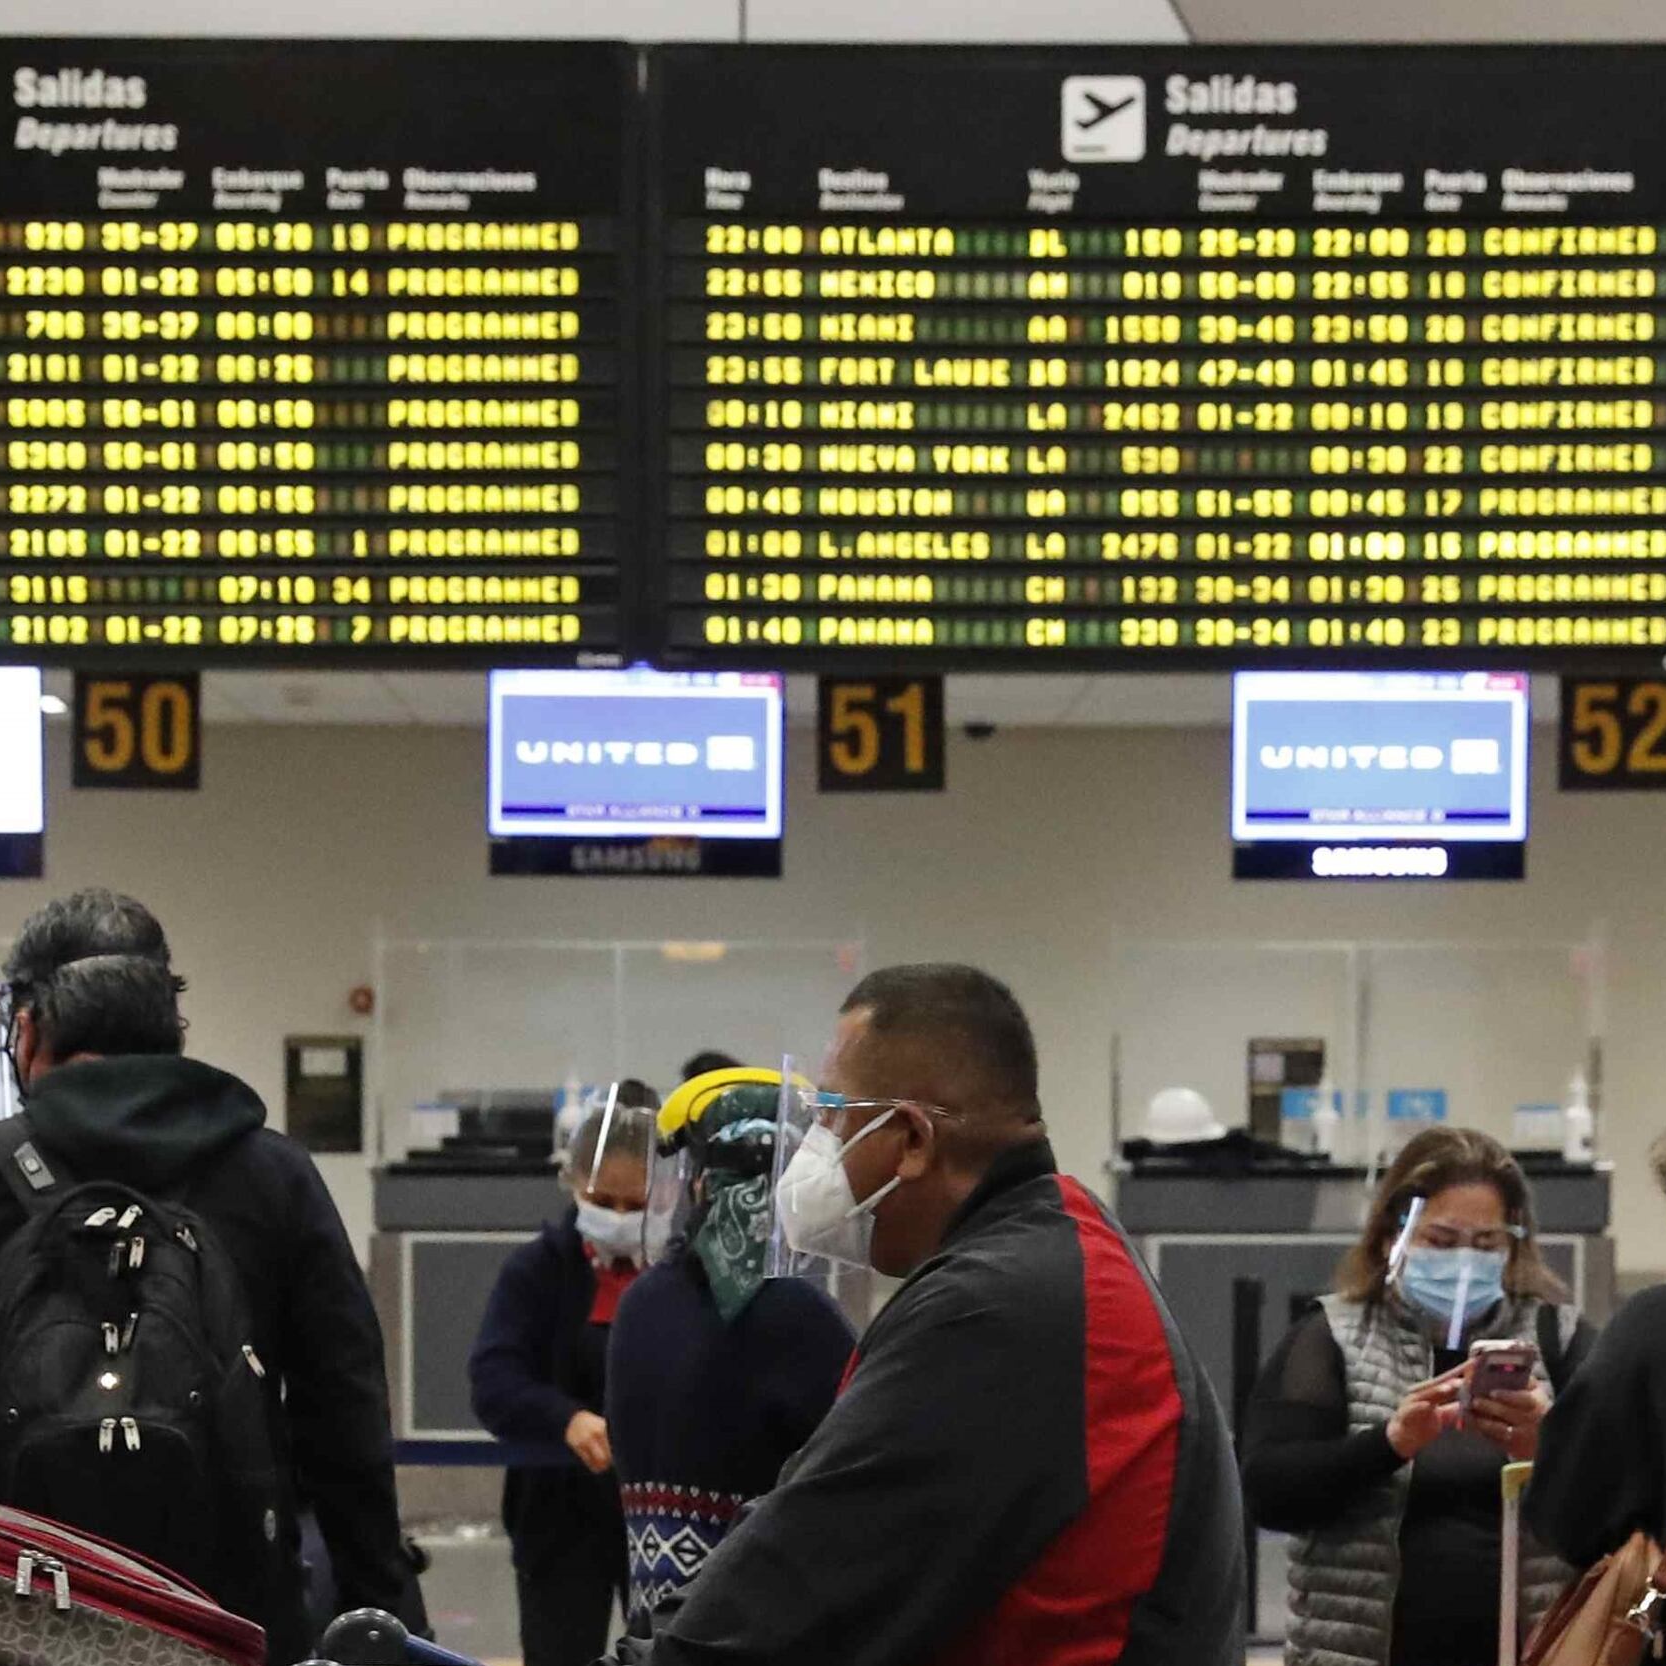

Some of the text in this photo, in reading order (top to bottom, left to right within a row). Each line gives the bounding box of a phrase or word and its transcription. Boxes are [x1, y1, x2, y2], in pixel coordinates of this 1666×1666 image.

[14, 66, 147, 109] Salidas
[1164, 73, 1297, 115] Salidas
[14, 116, 178, 157] Departures
[1165, 122, 1329, 162] Departures
[215, 222, 313, 251] 05:20
[387, 222, 579, 251] PROGRAMMED
[706, 225, 803, 255] 22:00
[819, 226, 954, 256] ATLANTA
[1313, 228, 1409, 257] 22:00
[1483, 226, 1656, 256] CONFIRMED
[101, 267, 199, 296] 01-22
[216, 267, 313, 297] 05:50
[333, 269, 369, 297] 14
[387, 267, 579, 296] PROGRAMMED
[706, 268, 803, 297] 22:55
[819, 269, 936, 299] MEXICO
[1312, 271, 1409, 300] 22:55
[1482, 270, 1655, 299] CONFIRMED
[216, 311, 313, 340] 06:00
[387, 311, 579, 340] PROGRAMMED
[706, 312, 1654, 343] 23:50 MIAMI AA 23:50 CONFIRMED
[102, 354, 200, 383] 01-22
[216, 354, 314, 383] 06:25
[388, 354, 578, 383] PROGRAMMED
[706, 356, 802, 385] 23:55
[1311, 358, 1408, 387] 01:45
[1481, 356, 1654, 386] CONFIRMED
[217, 399, 314, 428] 06:50
[388, 399, 579, 428] PROGRAMMED
[707, 399, 1653, 431] 00:10 MIAMI LA 01-22 00:10 CONFIRMED
[217, 441, 315, 470] 06:50
[388, 441, 579, 470] PROGRAMMED
[706, 442, 802, 472] 00:30
[819, 444, 916, 473] NUEVA
[932, 445, 1009, 474] YORK
[1027, 446, 1066, 474] LA
[1310, 445, 1407, 474] 00:30
[1480, 443, 1652, 473] CONFIRMED
[103, 485, 201, 514] 01-22
[217, 485, 315, 514] 06:55
[388, 484, 579, 513] PROGRAMMED
[705, 486, 802, 515] 00:45
[818, 487, 953, 516] HOUSTON
[1026, 489, 1066, 517] UA
[1309, 488, 1406, 517] 00:45
[1425, 489, 1462, 517] 17
[104, 529, 201, 558] 01-22
[218, 529, 315, 558] 06:55
[353, 530, 367, 557] 1
[389, 528, 579, 557] PROGRAMMED
[706, 530, 802, 558] 01:00
[1025, 532, 1066, 560] LA
[1196, 532, 1291, 560] 01-22
[1308, 531, 1406, 561] 01:00
[218, 575, 315, 604] 07:10
[389, 576, 579, 604] PROGRAMMED
[705, 572, 801, 601] 01:30
[818, 574, 933, 602] PANAMA
[1025, 576, 1065, 603] CM
[1308, 575, 1405, 603] 01:30
[105, 615, 202, 644] 01-22
[219, 615, 315, 644] 07:25
[351, 615, 372, 643] 7
[389, 614, 580, 643] PROGRAMMED
[705, 615, 802, 645] 01:40
[819, 617, 934, 645] PANAMA
[1026, 618, 1066, 646] CM
[1308, 618, 1405, 646] 01:40
[84, 682, 192, 774] 50
[829, 684, 927, 775] 51
[515, 740, 699, 766] UNITED
[1260, 745, 1443, 770] UNITED
[572, 845, 701, 870] SAMSUNG
